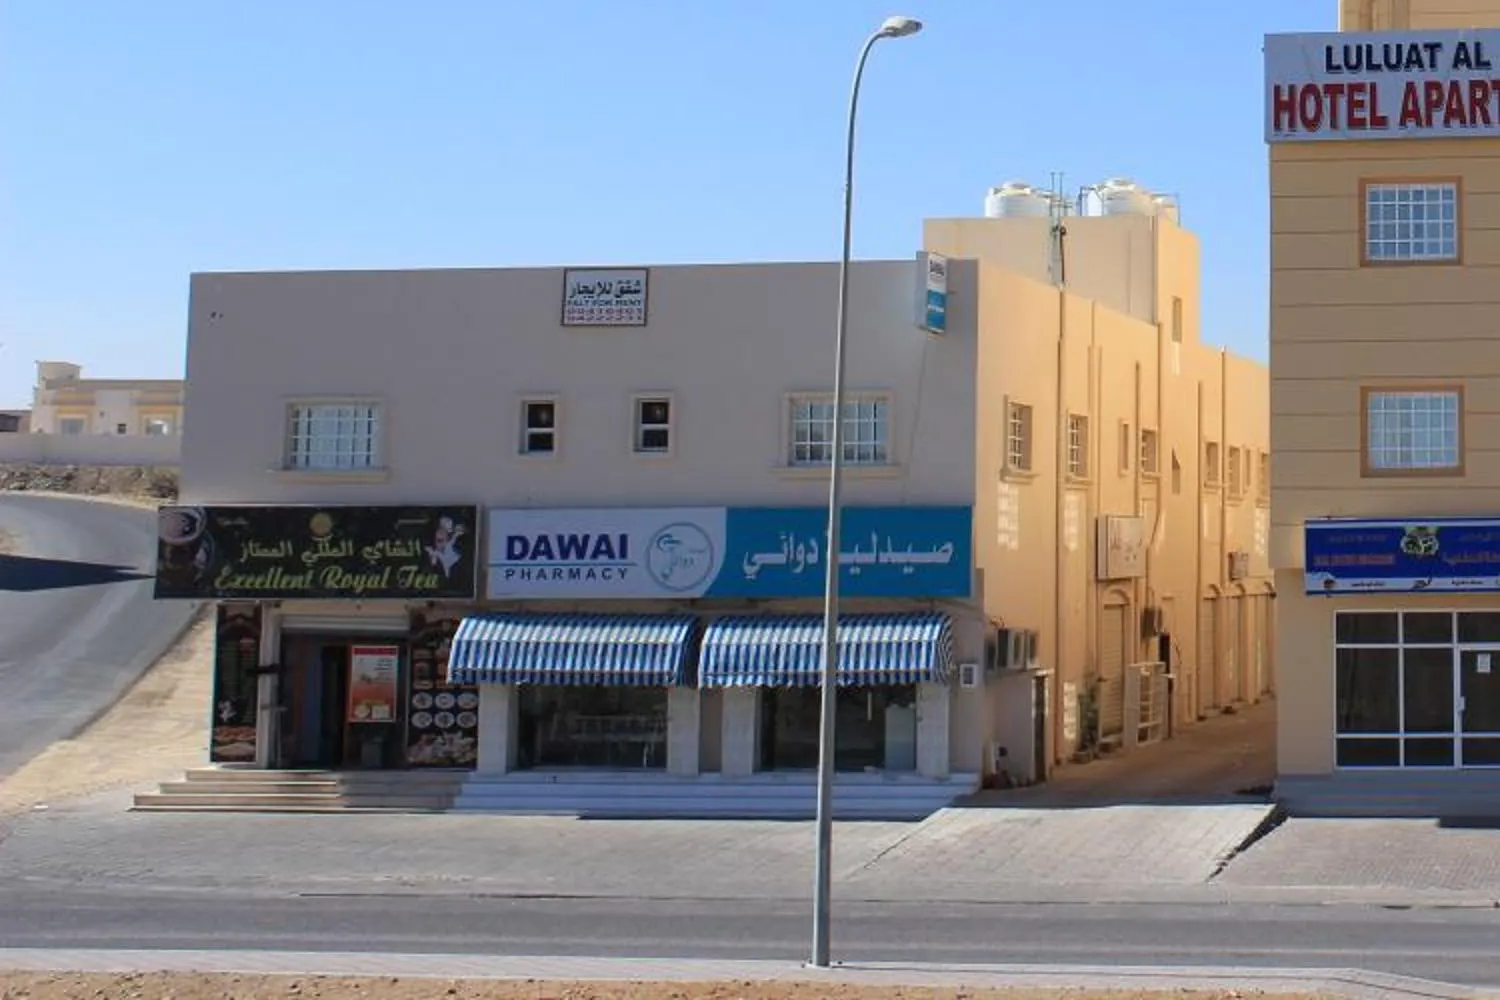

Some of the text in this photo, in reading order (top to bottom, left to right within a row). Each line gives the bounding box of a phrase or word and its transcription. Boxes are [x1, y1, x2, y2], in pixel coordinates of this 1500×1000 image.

[1325, 42, 1442, 74] LULUAT
[1452, 41, 1492, 71] AL
[1273, 82, 1389, 132] HOTEL
[506, 533, 629, 561] DAWAI
[827, 530, 953, 574] صيدلي
[214, 564, 439, 594] Excellent Royal Tea
[504, 567, 628, 581] PHARMACY
